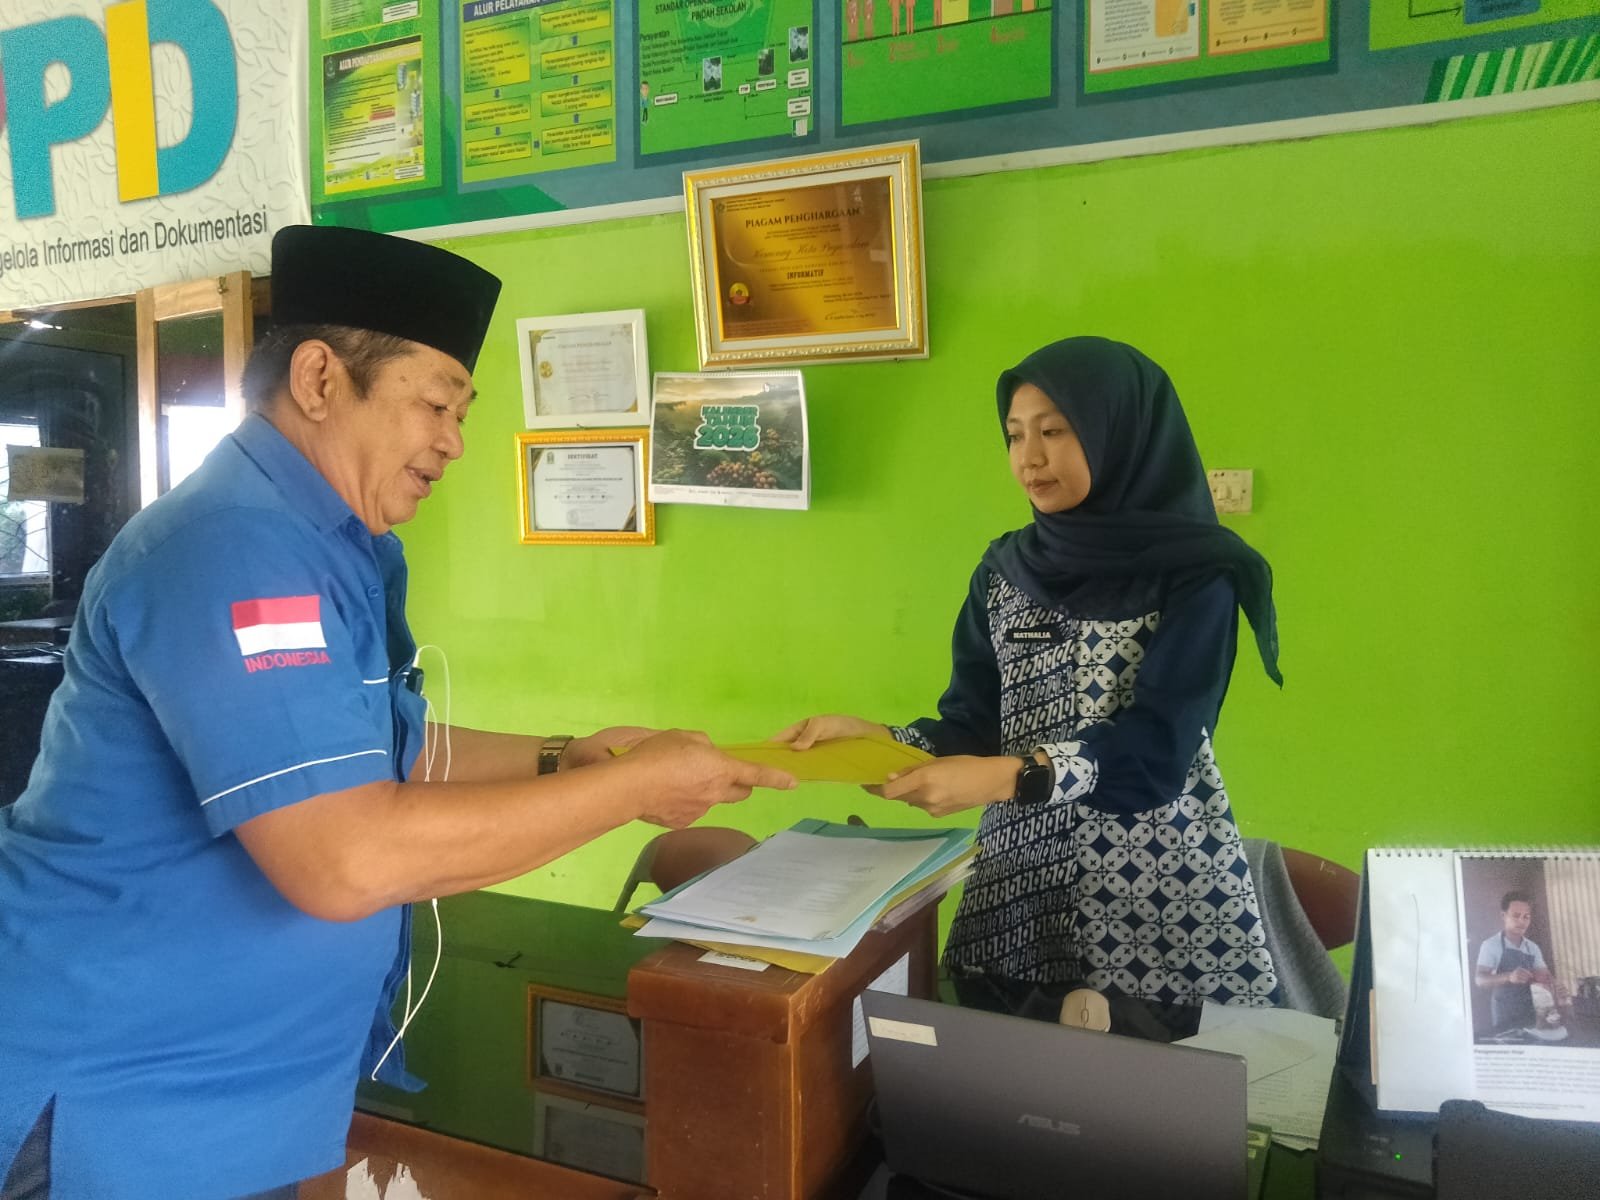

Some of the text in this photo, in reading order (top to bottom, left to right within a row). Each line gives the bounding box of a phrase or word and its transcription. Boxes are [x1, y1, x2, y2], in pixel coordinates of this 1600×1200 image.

[474, 0, 541, 16] ALUR PELAYA
[0, 0, 239, 220] PID
[745, 207, 861, 229] PIAGAM PENGHARGAAN
[43, 229, 114, 266] Informasi
[119, 226, 149, 255] dan
[154, 203, 267, 249] Dokumentasi
[696, 424, 759, 449] 2026
[244, 651, 332, 673] INDONESIA
[1017, 1114, 1081, 1136] ASUS
